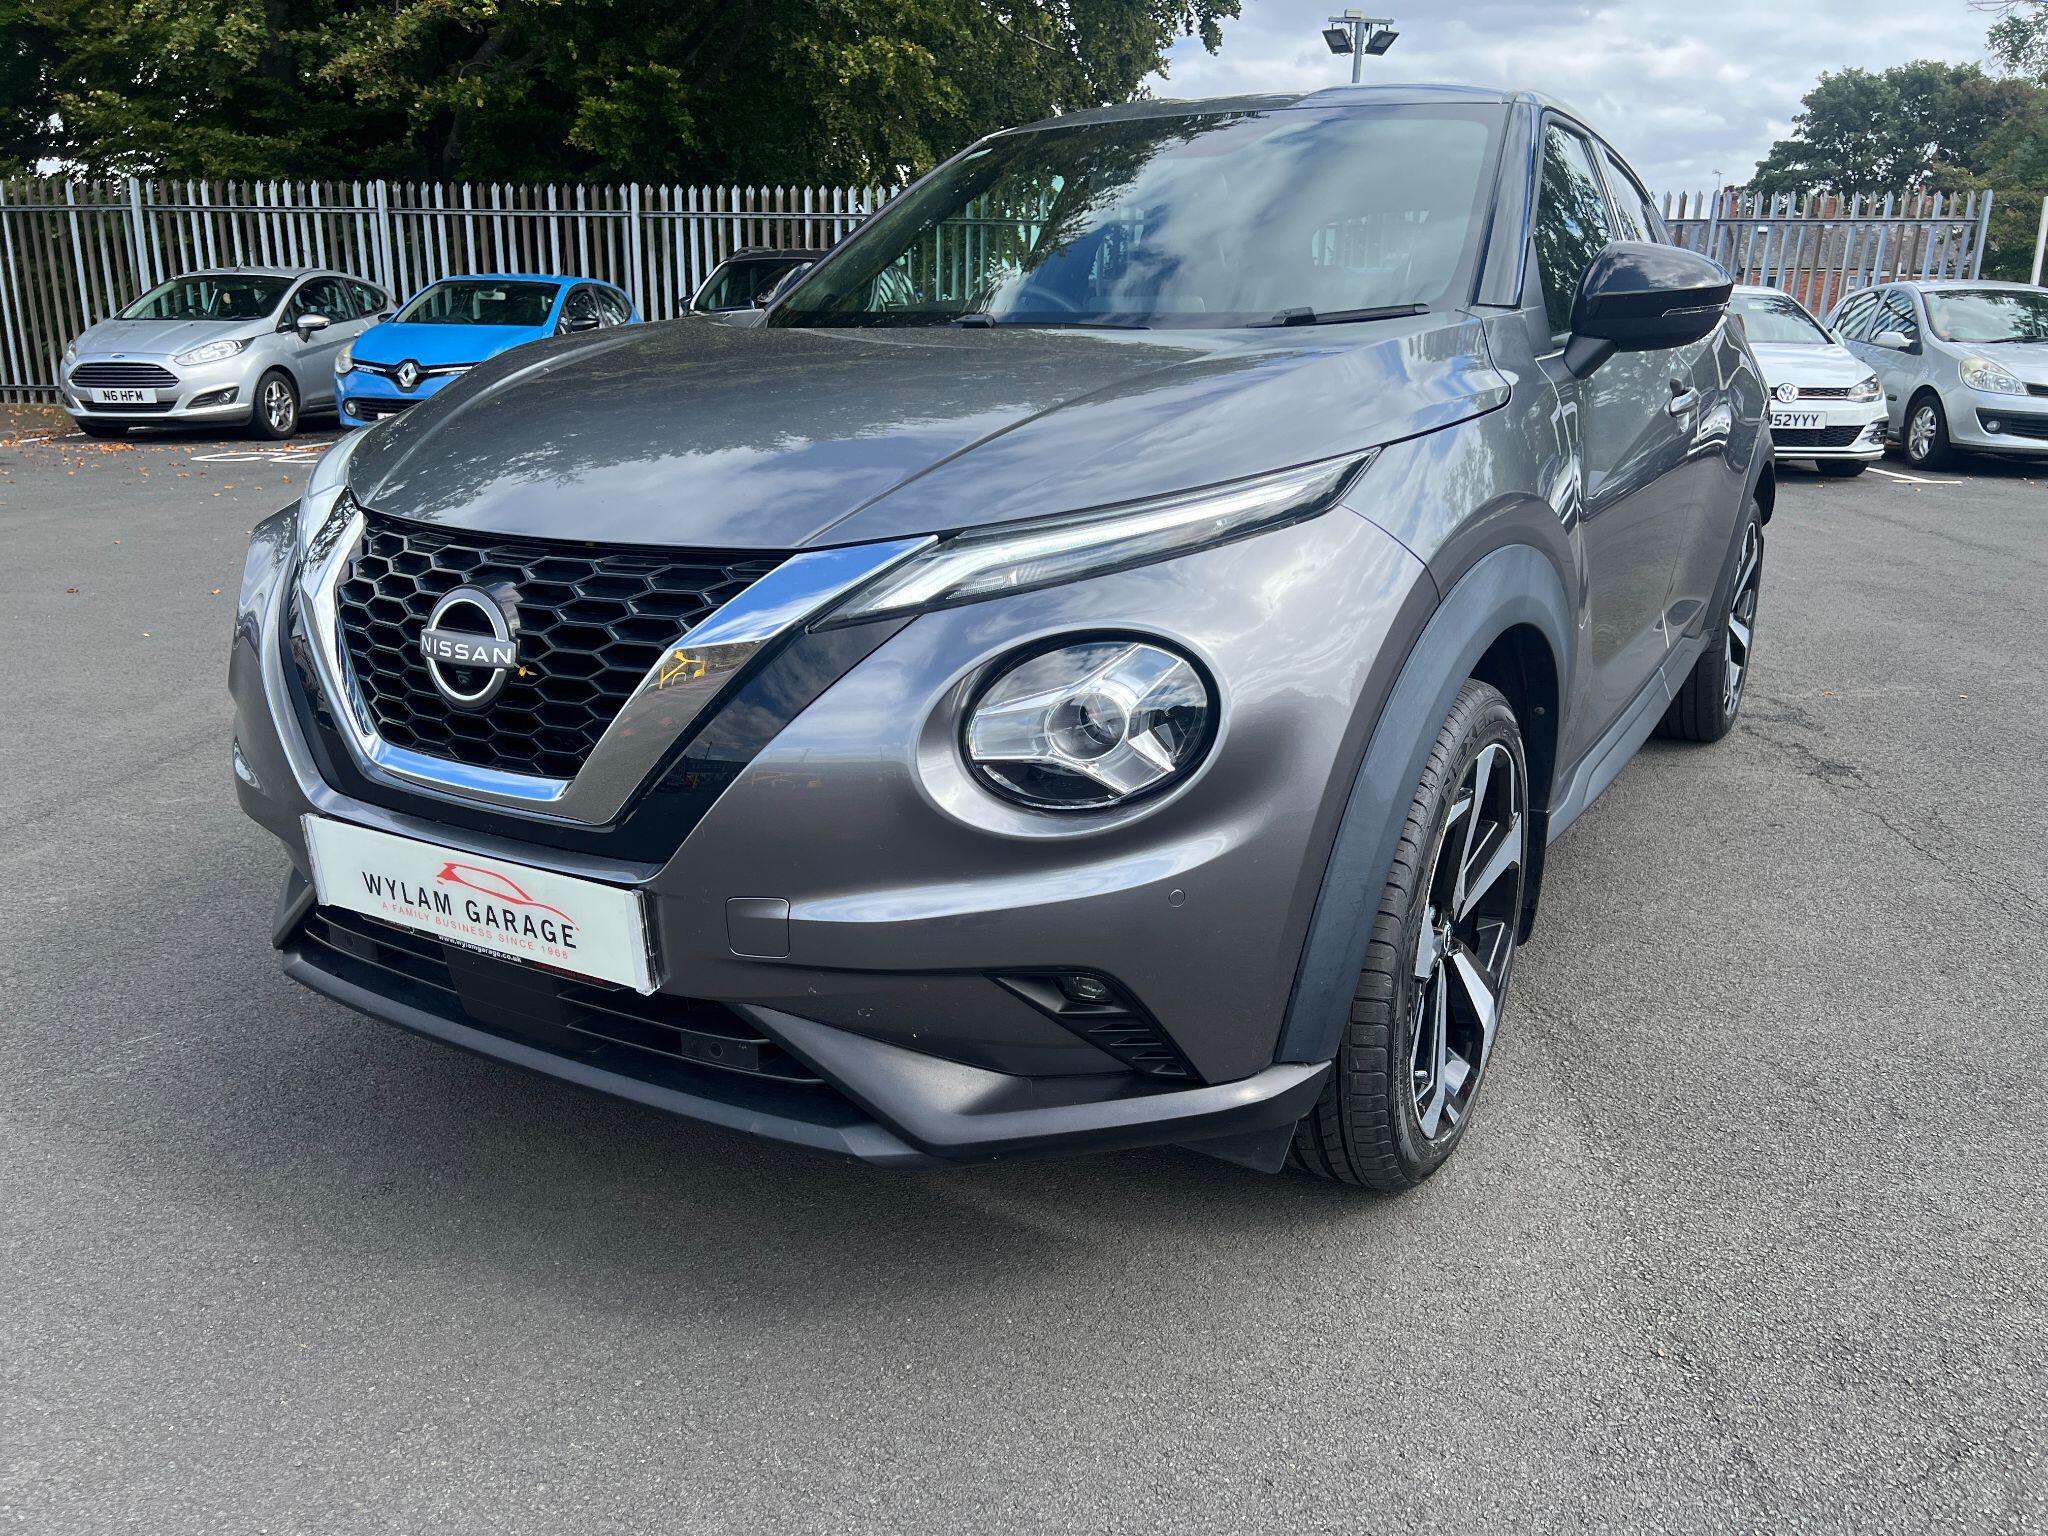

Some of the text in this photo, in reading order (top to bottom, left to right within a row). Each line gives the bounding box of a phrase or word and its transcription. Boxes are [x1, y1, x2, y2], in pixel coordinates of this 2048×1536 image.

[102, 390, 144, 401] N6 HFM
[421, 635, 512, 664] NISSAN
[362, 871, 577, 949] WYLAM GARAGE
[382, 901, 388, 910] A
[392, 904, 430, 920] FAMILY
[435, 916, 493, 940] BUSINESS
[498, 933, 534, 951] SINCE
